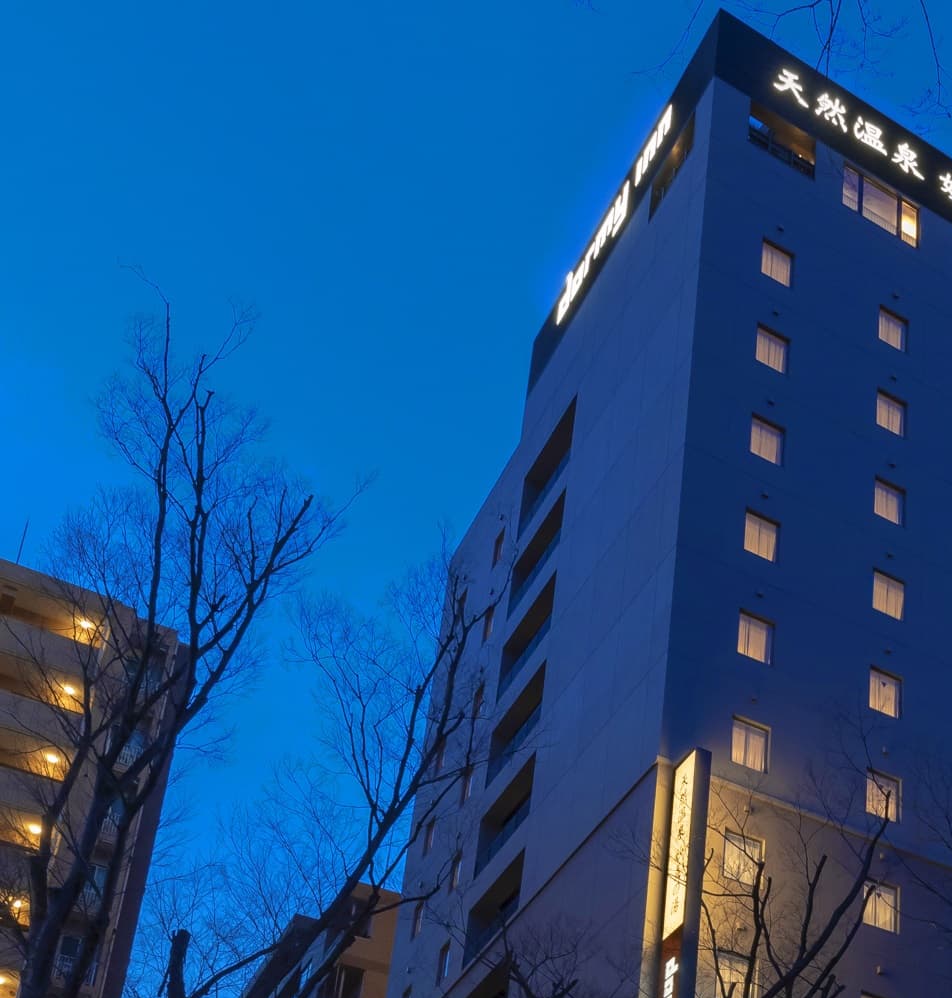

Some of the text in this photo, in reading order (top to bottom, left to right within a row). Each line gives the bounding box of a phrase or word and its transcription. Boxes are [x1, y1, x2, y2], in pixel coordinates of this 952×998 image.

[772, 68, 925, 181] 天然温泉
[555, 103, 674, 326] dormy inn
